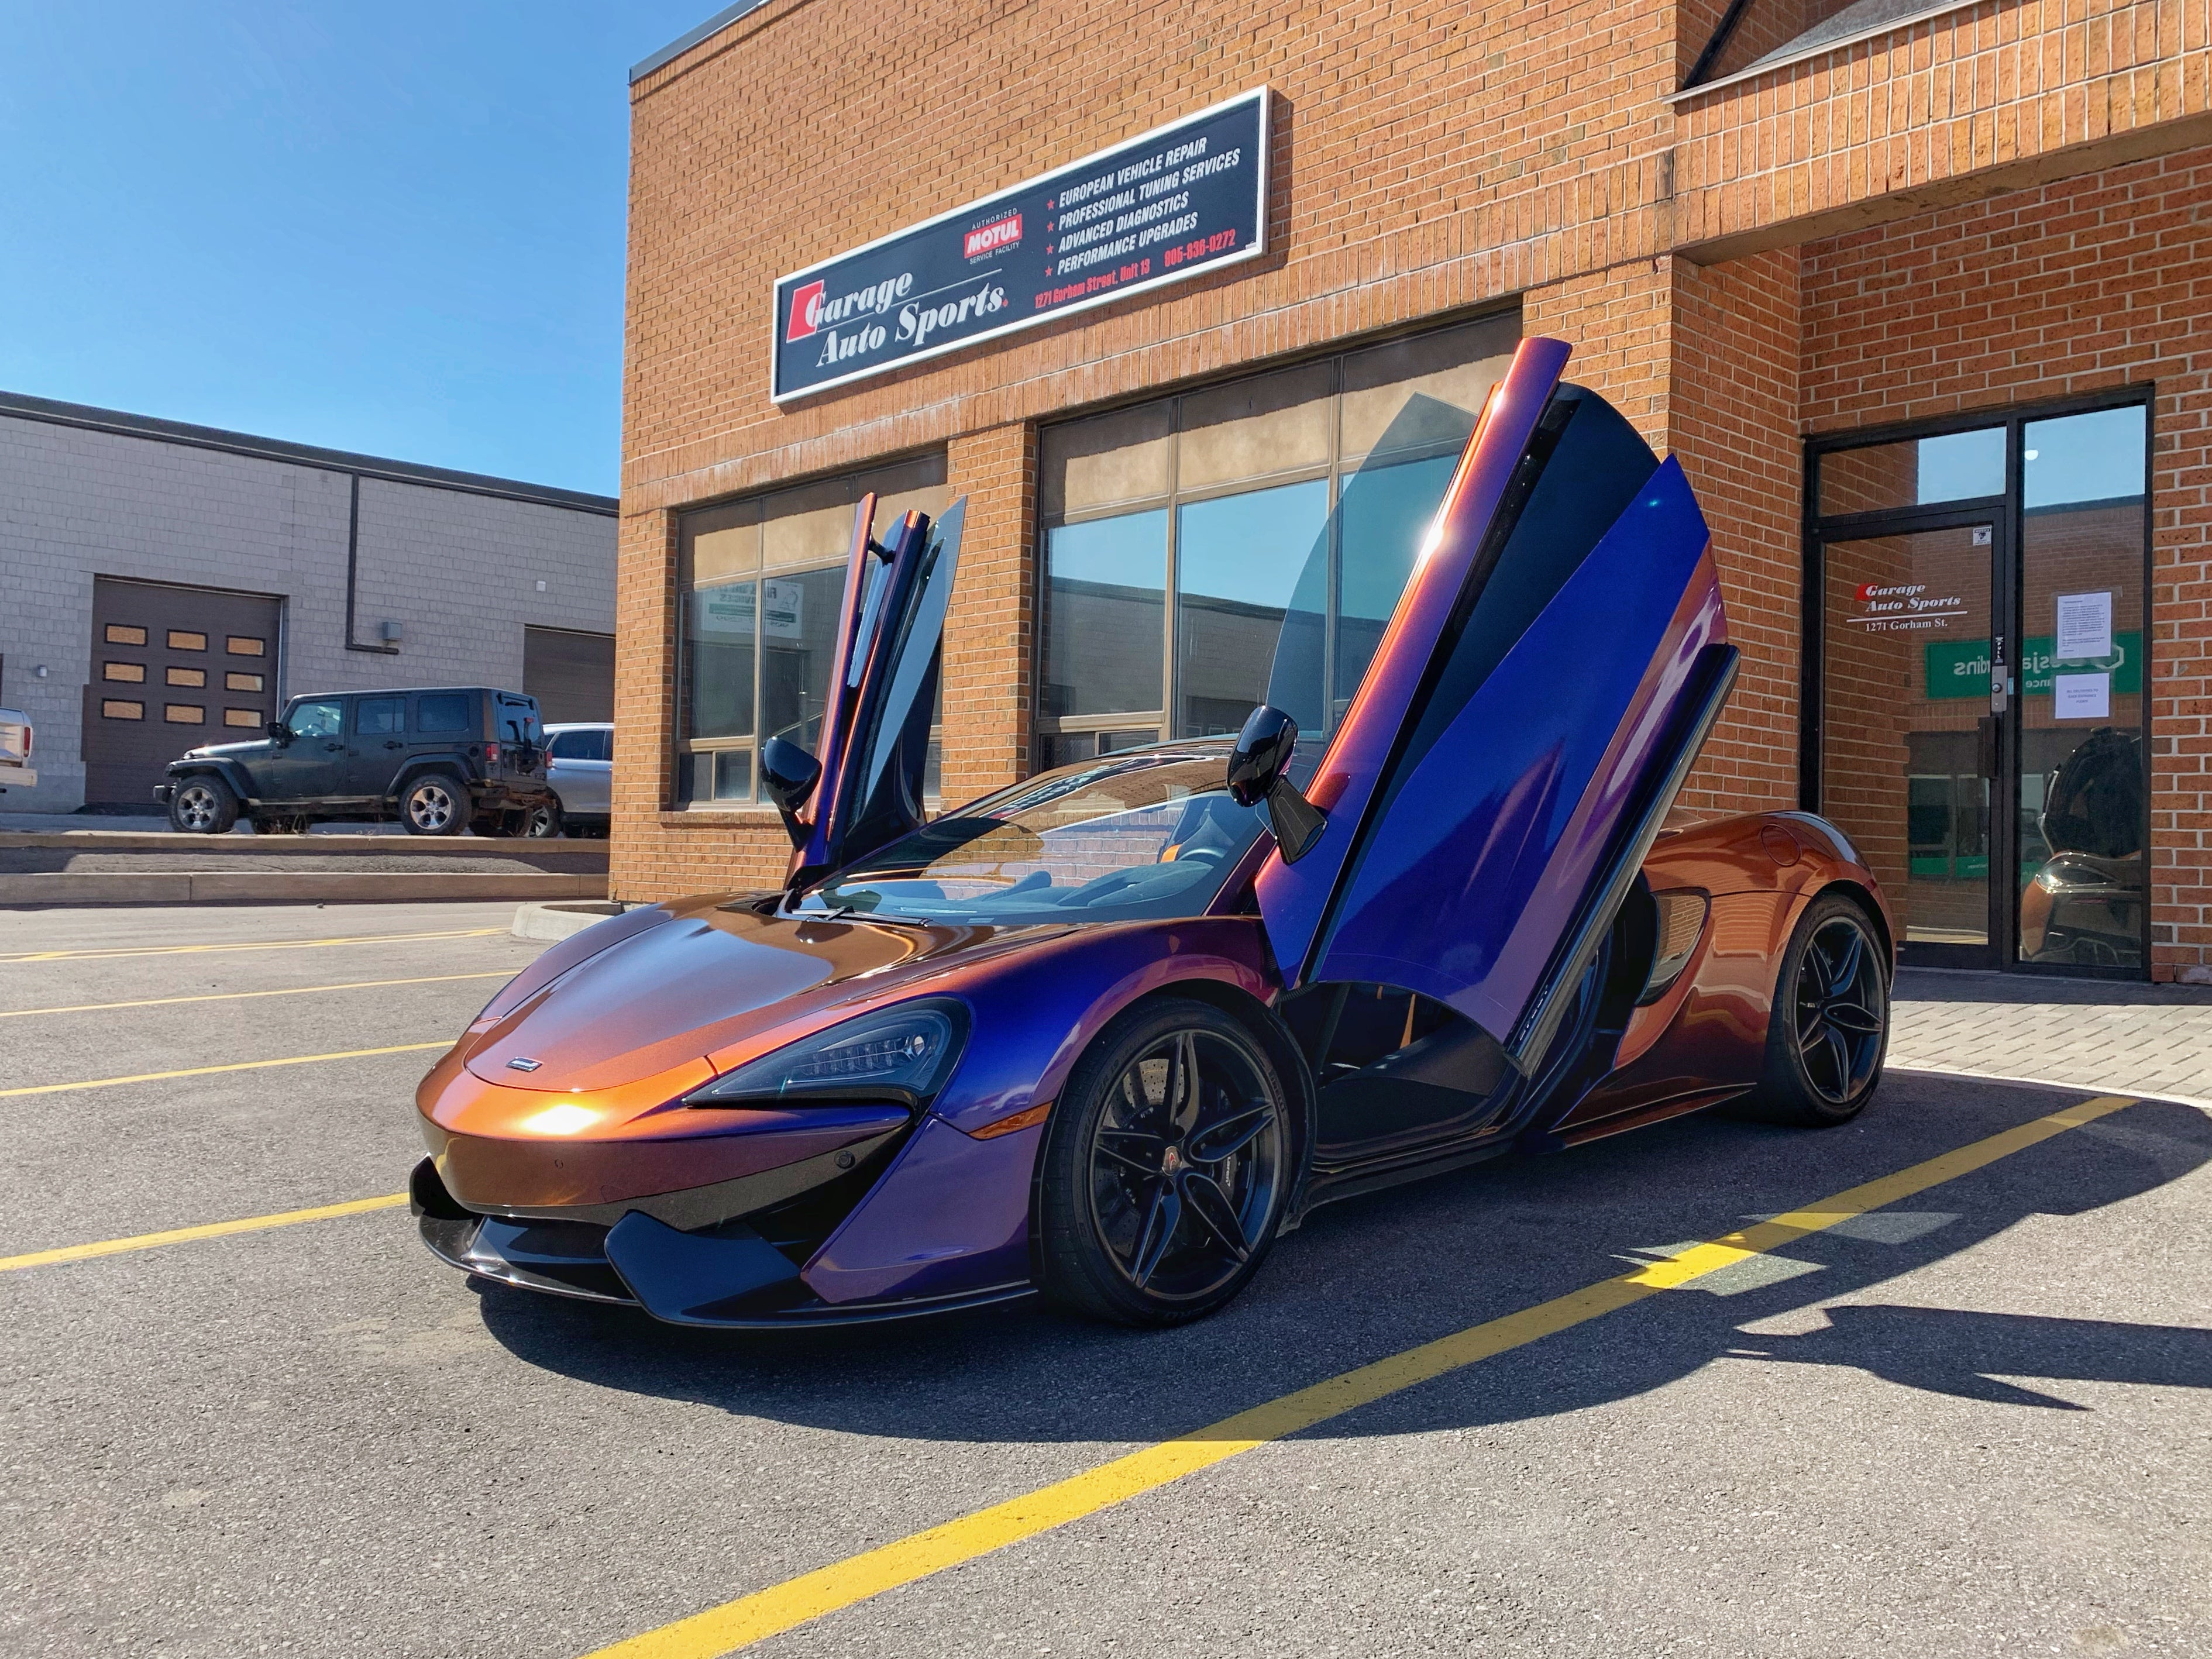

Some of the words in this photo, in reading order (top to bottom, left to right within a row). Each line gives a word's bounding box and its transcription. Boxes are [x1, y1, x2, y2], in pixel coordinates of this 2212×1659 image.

[1058, 194, 1136, 231] PROFESSIONAL
[1139, 171, 1179, 201] TUNING
[1182, 147, 1241, 185] SERVICES
[1059, 173, 1114, 208] EUROPEAN
[1117, 154, 1163, 187] VEHICLE
[1165, 136, 1208, 168] REPAIR
[966, 219, 1019, 254] MOTUL
[971, 208, 1017, 230] AUTHORIZED
[1058, 219, 1114, 253] ADVANCED
[1116, 191, 1189, 232] DIAGNOSTICS
[969, 251, 993, 265] SERVICE
[995, 240, 1020, 256] FACILITY
[1057, 236, 1135, 276] PERFORMANCE
[1138, 211, 1199, 248] UPGRADES
[804, 272, 913, 328] Garage
[1035, 292, 1052, 309] 1271
[1052, 282, 1085, 304] Gorham
[1120, 262, 1138, 282] Unit
[1140, 258, 1151, 275] 13
[815, 321, 887, 368] Auto
[1864, 600, 1903, 612] Auto
[1907, 596, 1961, 611] Sports
[1865, 584, 1926, 597] Garage
[1865, 622, 1887, 632] 1271
[1890, 620, 1931, 630] Gorham
[1934, 618, 1948, 628] St.
